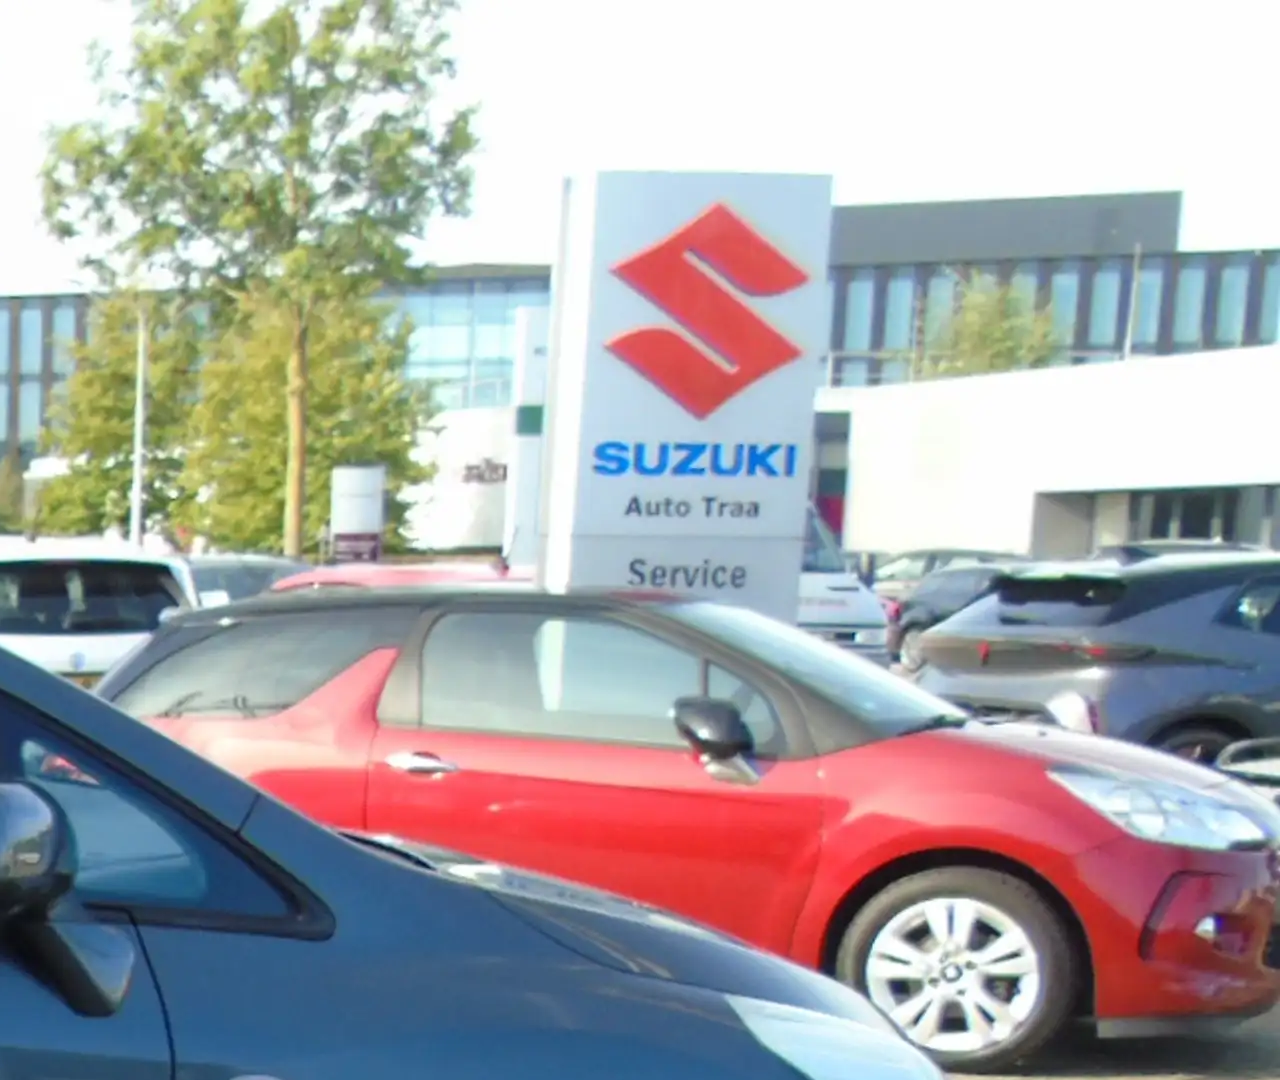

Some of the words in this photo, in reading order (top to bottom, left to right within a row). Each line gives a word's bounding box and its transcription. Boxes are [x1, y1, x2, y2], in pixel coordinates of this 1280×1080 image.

[592, 441, 797, 477] SUZUKI
[625, 495, 691, 518] Auto
[702, 496, 761, 518] Traa
[627, 558, 747, 589] Service
